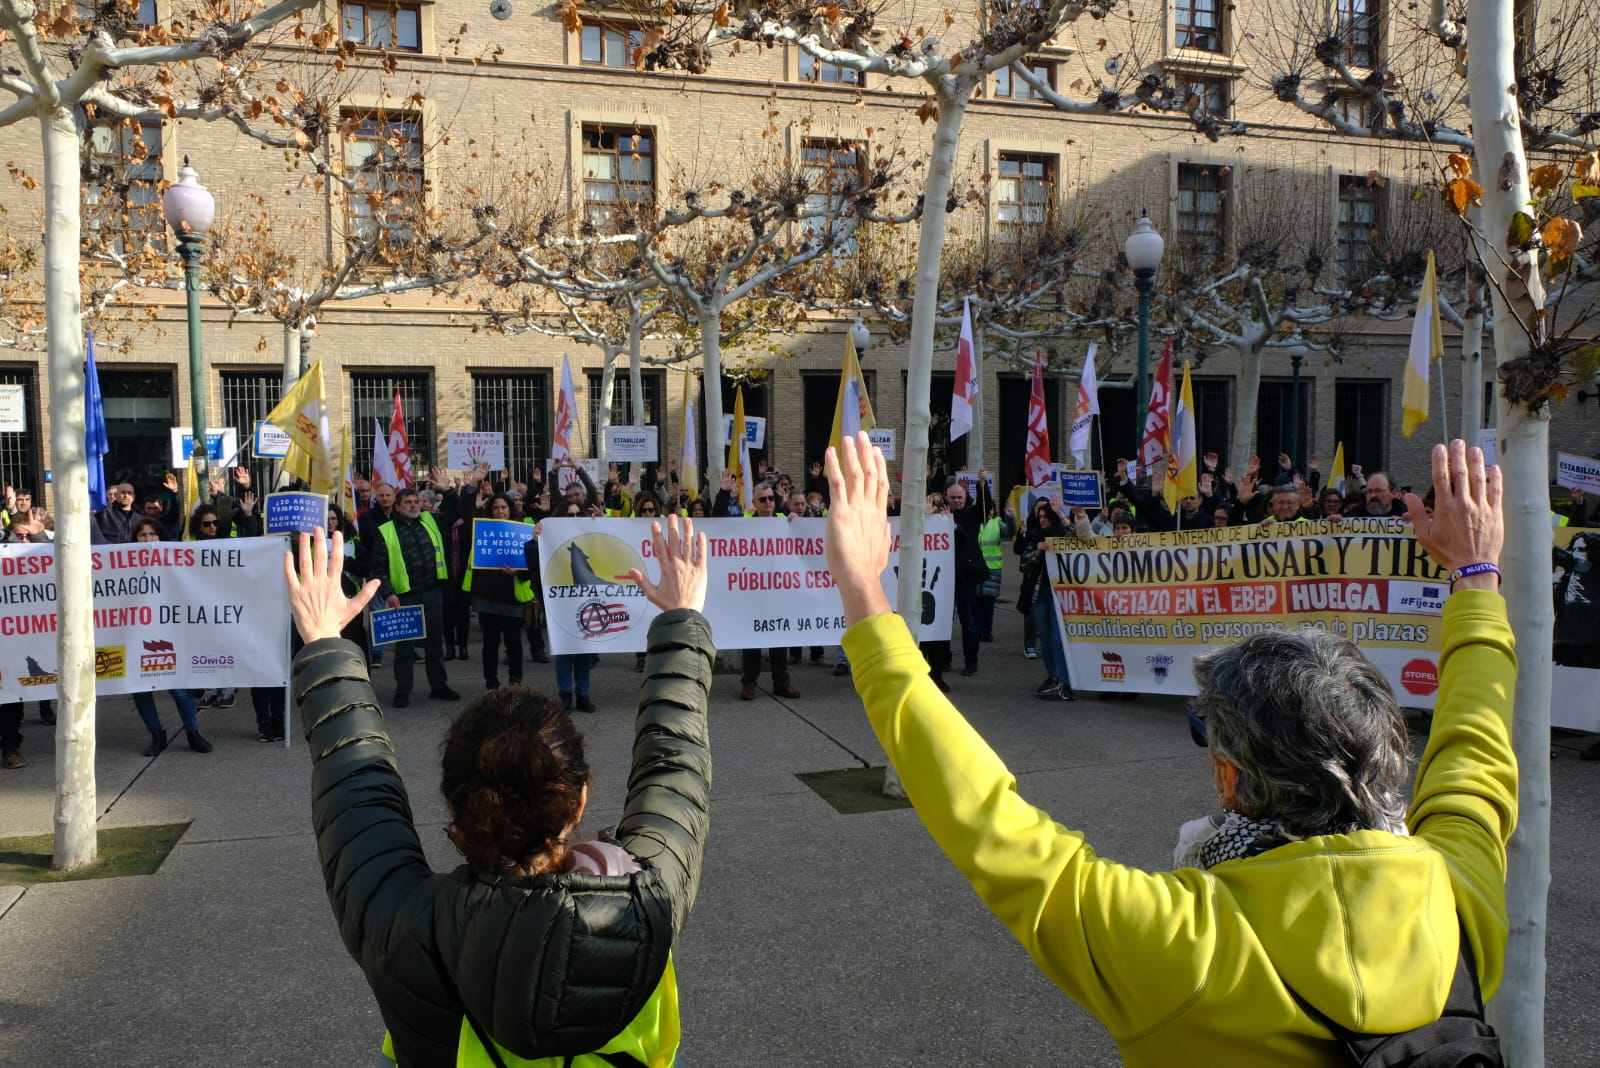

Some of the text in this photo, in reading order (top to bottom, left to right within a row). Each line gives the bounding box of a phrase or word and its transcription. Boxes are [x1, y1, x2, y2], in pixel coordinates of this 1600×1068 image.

[1560, 461, 1600, 477] ESTABILIZA
[483, 530, 495, 538] LA
[1053, 537, 1099, 550] PERSONAL
[1160, 532, 1167, 547] E
[1173, 527, 1224, 546] INTERINO
[1229, 526, 1242, 542] DE
[1247, 523, 1271, 541] LAS
[1276, 517, 1405, 538] ADMINISTRACIONES
[492, 539, 525, 548] NEGOC
[496, 548, 524, 556] CUMP
[709, 537, 824, 557] TRABAJADORAS
[2, 548, 245, 576] DESPS ILEGALES EN EL
[1055, 552, 1090, 585] NO
[1096, 548, 1190, 585] SOMOS
[1195, 544, 1235, 582] DE
[1239, 538, 1330, 580] USAR
[1332, 537, 1356, 575] Y
[93, 571, 161, 598] ARAGÓN
[728, 567, 801, 591] PÚBLICOS
[1056, 589, 1080, 615] NO
[1083, 590, 1101, 615] AL
[1175, 588, 1199, 614] EN
[1202, 586, 1228, 613] EL
[1231, 584, 1278, 614] EBEP
[1291, 582, 1382, 612] HUELGA
[1400, 597, 1446, 609] #Fijeza
[160, 605, 181, 624] DE
[188, 605, 208, 624] LA
[214, 605, 244, 624] LEY
[753, 617, 790, 632] BASTA
[797, 616, 812, 631] YA
[815, 616, 830, 630] DE
[1172, 618, 1196, 638] de
[1352, 617, 1429, 644] plazas
[142, 655, 175, 667] STEA
[191, 655, 235, 665] SOMOS
